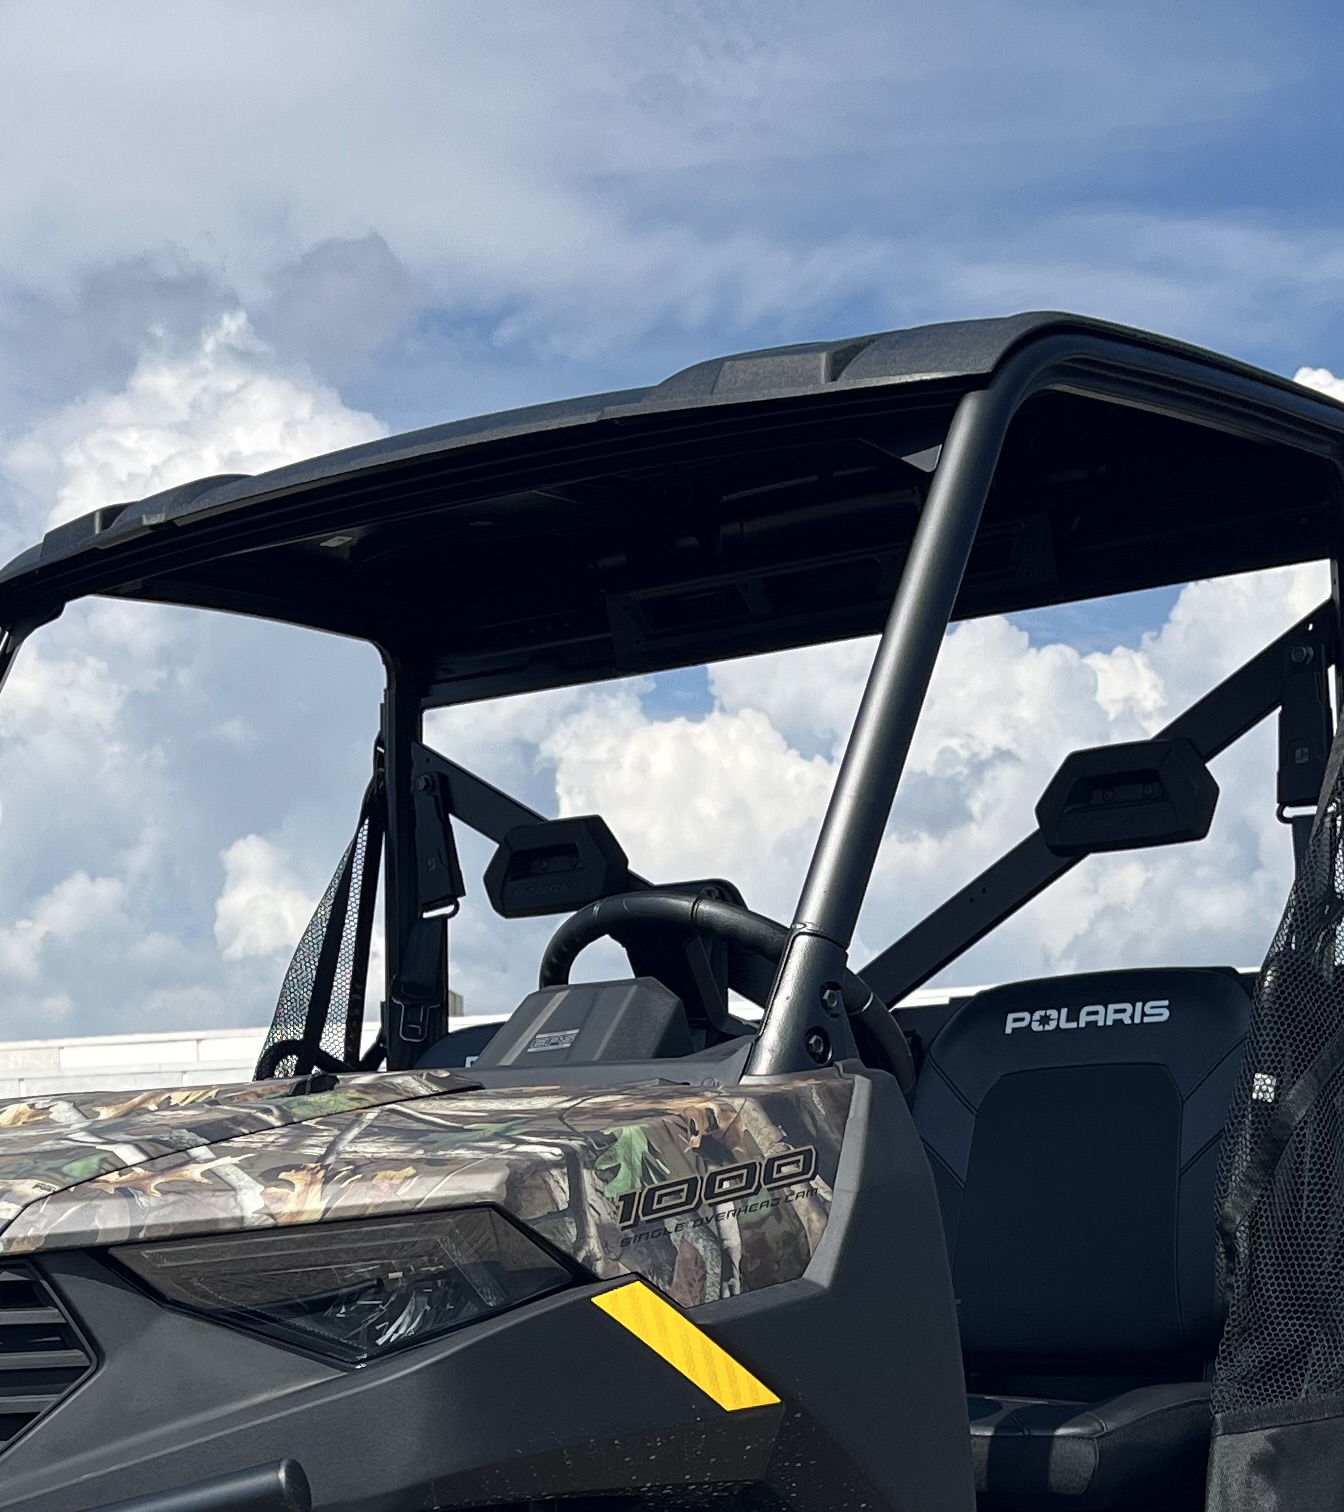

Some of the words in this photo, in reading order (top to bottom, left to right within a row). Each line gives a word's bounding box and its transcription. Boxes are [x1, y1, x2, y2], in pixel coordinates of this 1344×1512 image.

[1004, 999, 1171, 1035] POLARIS
[616, 1144, 820, 1232] 1000
[619, 1221, 686, 1248] SINGLE
[692, 1197, 782, 1230] OVERHEAD
[783, 1187, 820, 1205] CAM
